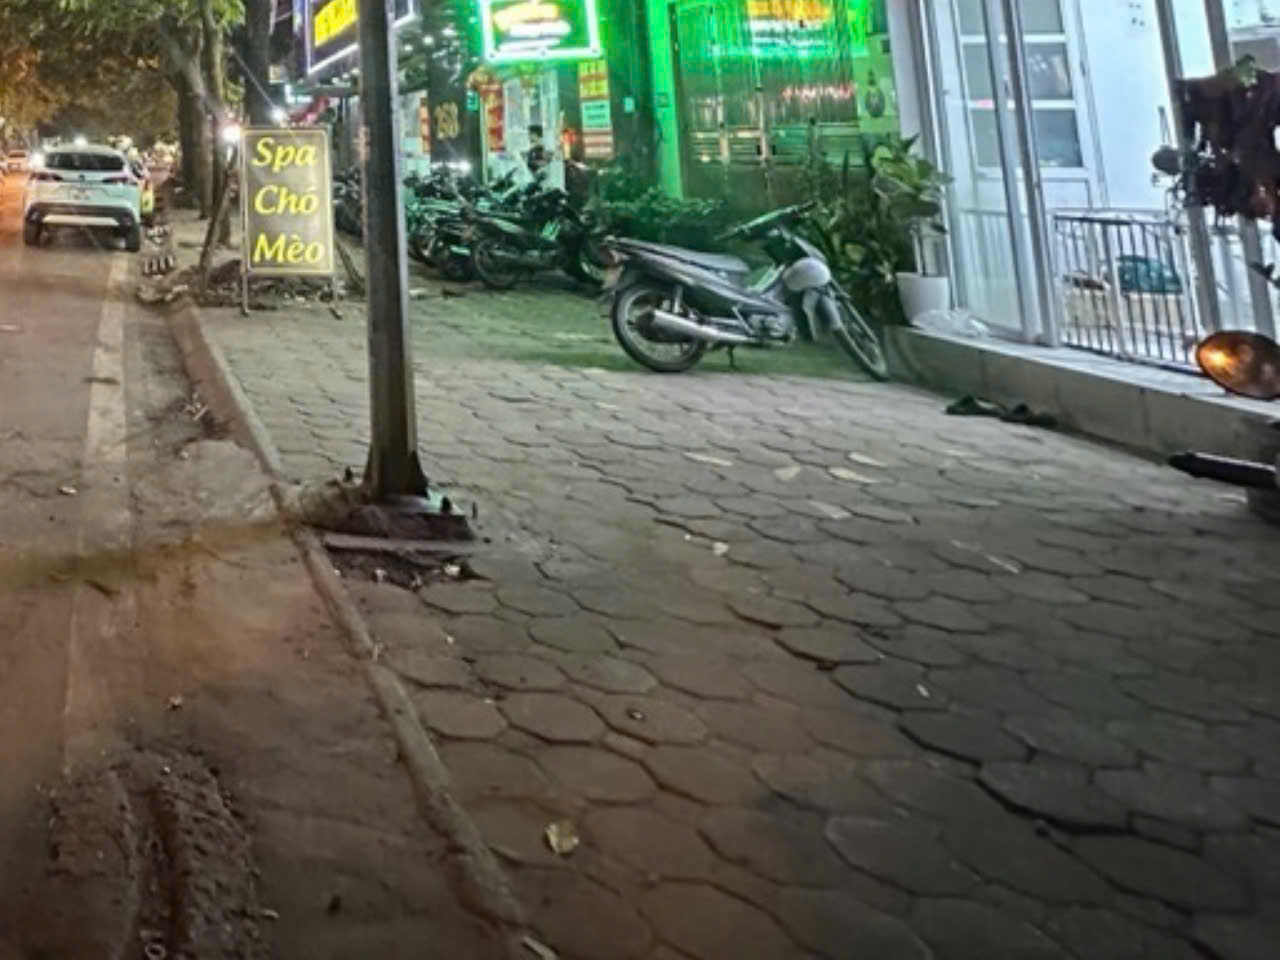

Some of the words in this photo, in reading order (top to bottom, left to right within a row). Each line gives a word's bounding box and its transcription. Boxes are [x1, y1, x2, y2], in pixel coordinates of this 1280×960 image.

[252, 136, 317, 173] Spa
[254, 184, 319, 215] Chó
[252, 232, 326, 263] Mèo
